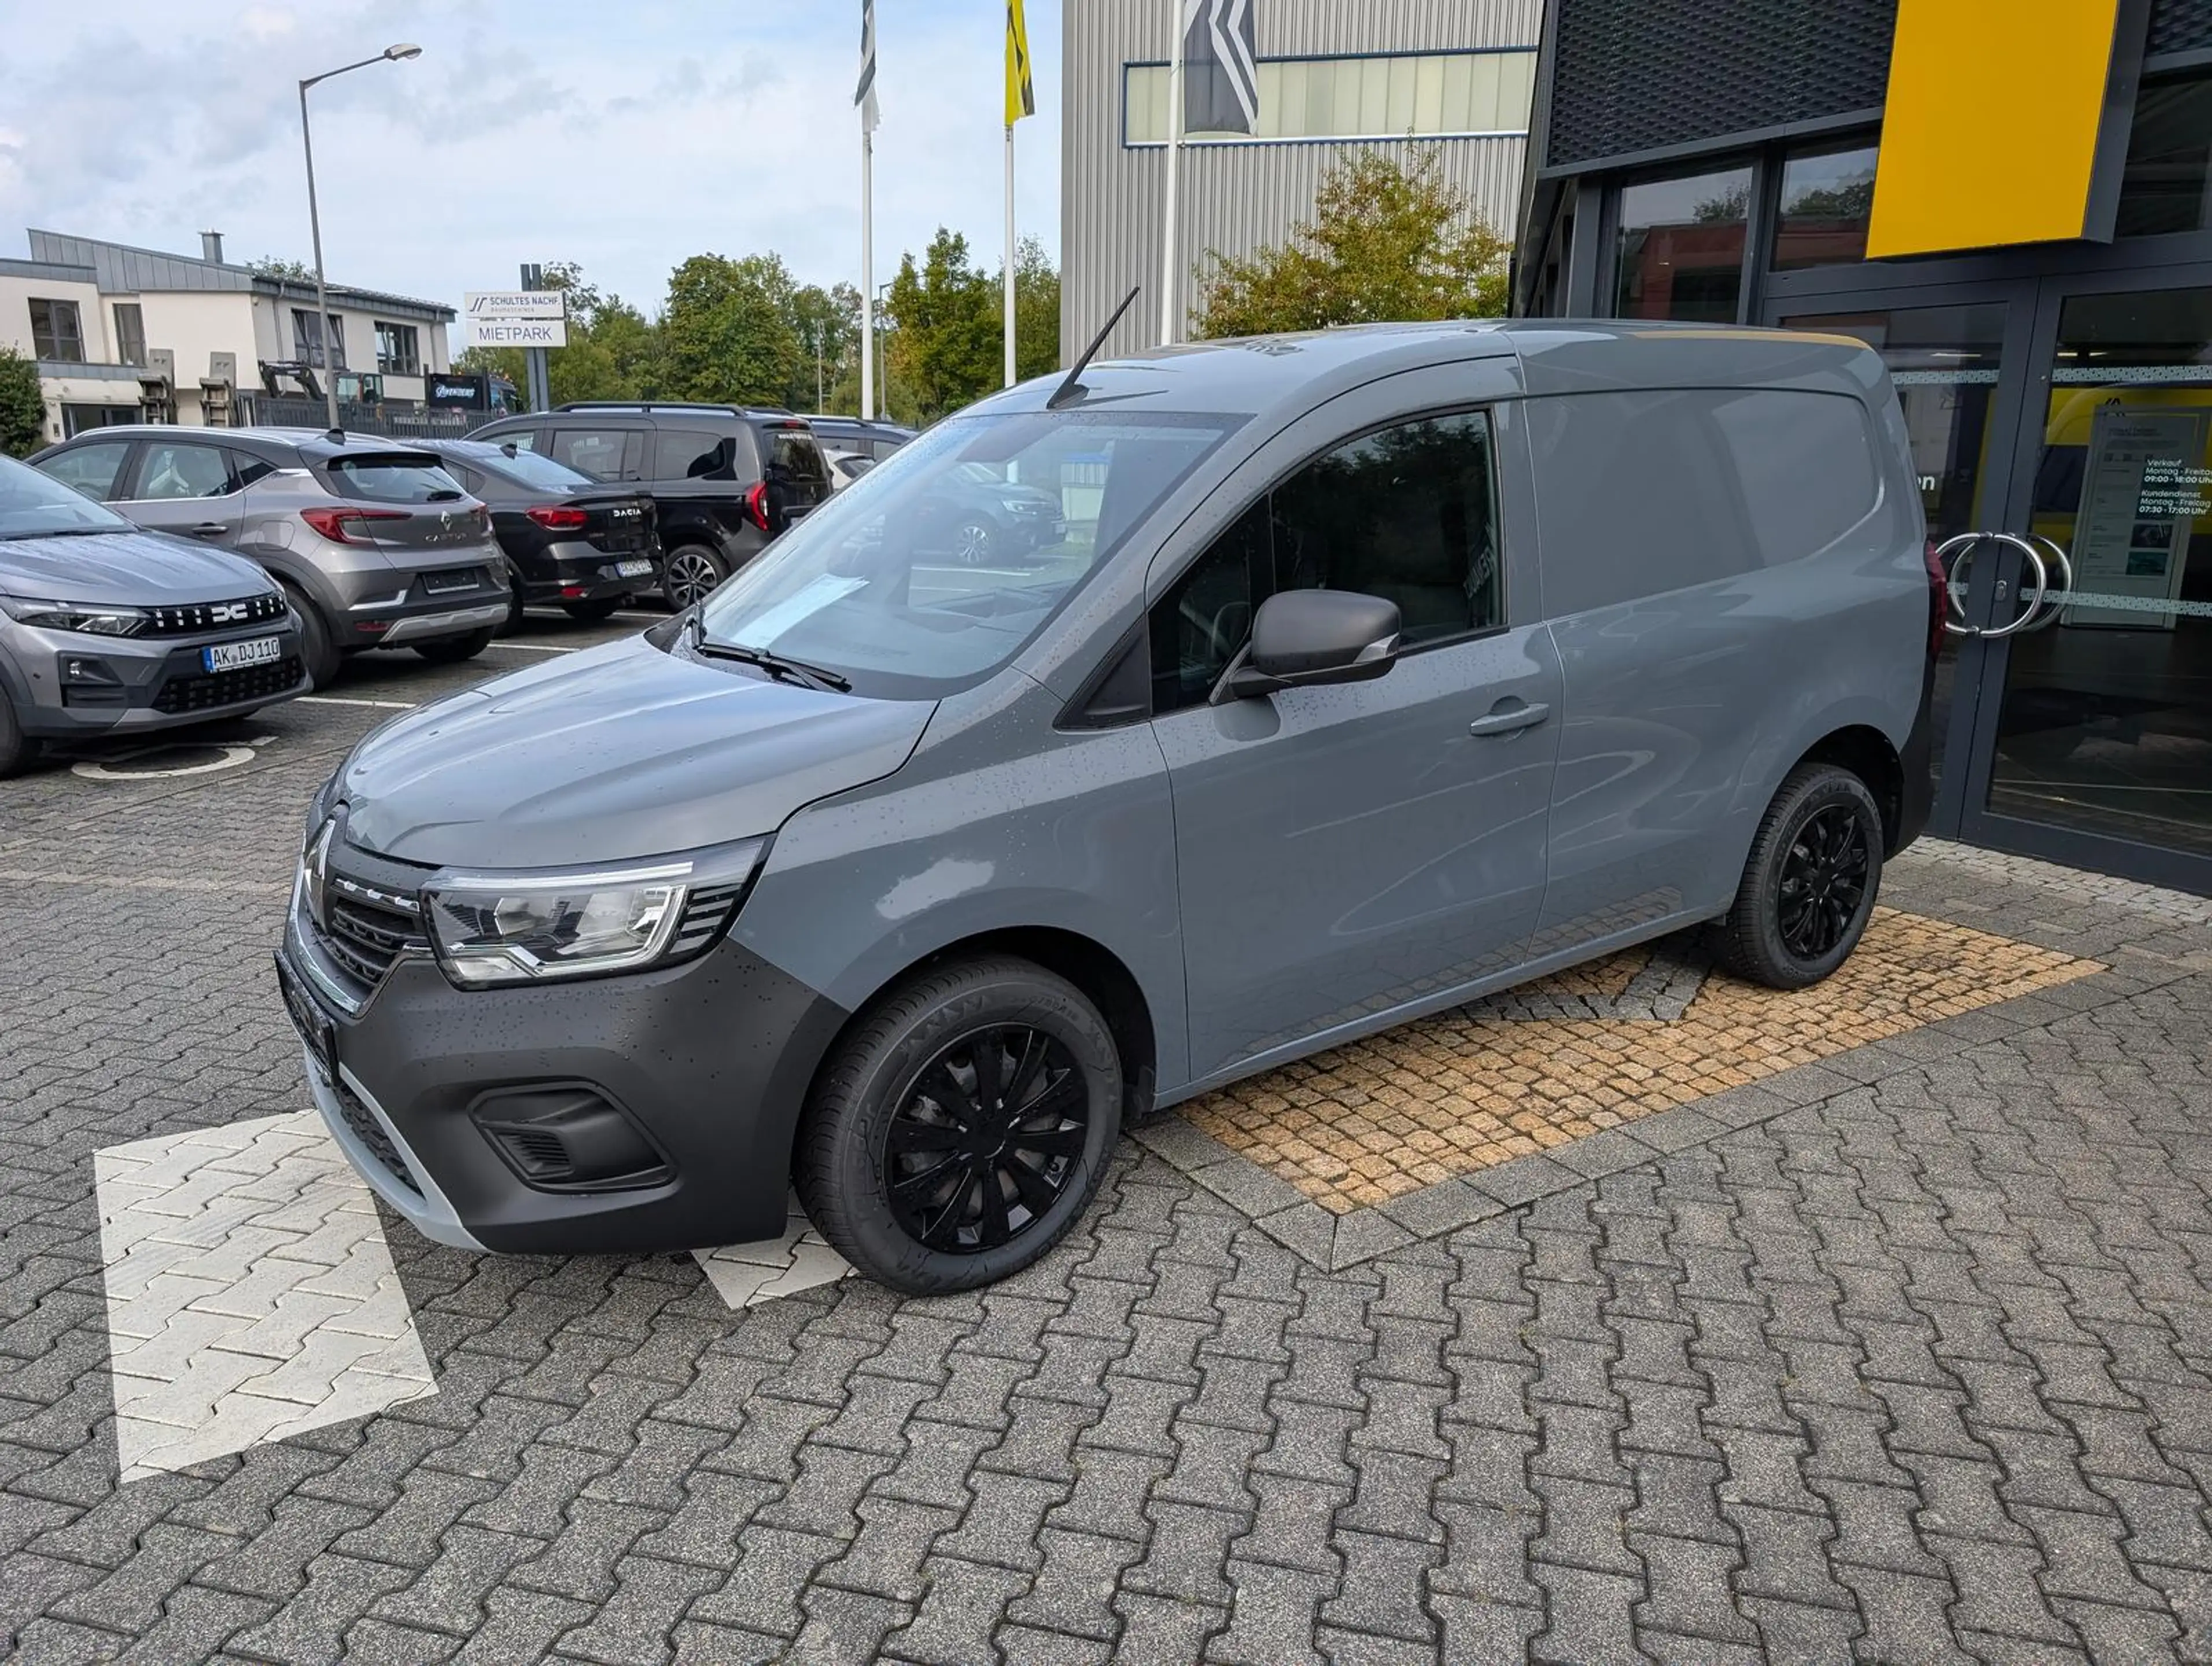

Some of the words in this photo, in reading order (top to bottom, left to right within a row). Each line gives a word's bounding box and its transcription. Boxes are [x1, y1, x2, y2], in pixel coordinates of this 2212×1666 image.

[490, 297, 529, 305] SCHULTES
[532, 297, 561, 305] NACHF.
[479, 327, 552, 341] MIETPARK
[2146, 467, 2178, 476] Montag
[2141, 498, 2174, 506] Montag
[2180, 499, 2211, 508] Freitag
[213, 647, 230, 665] AK
